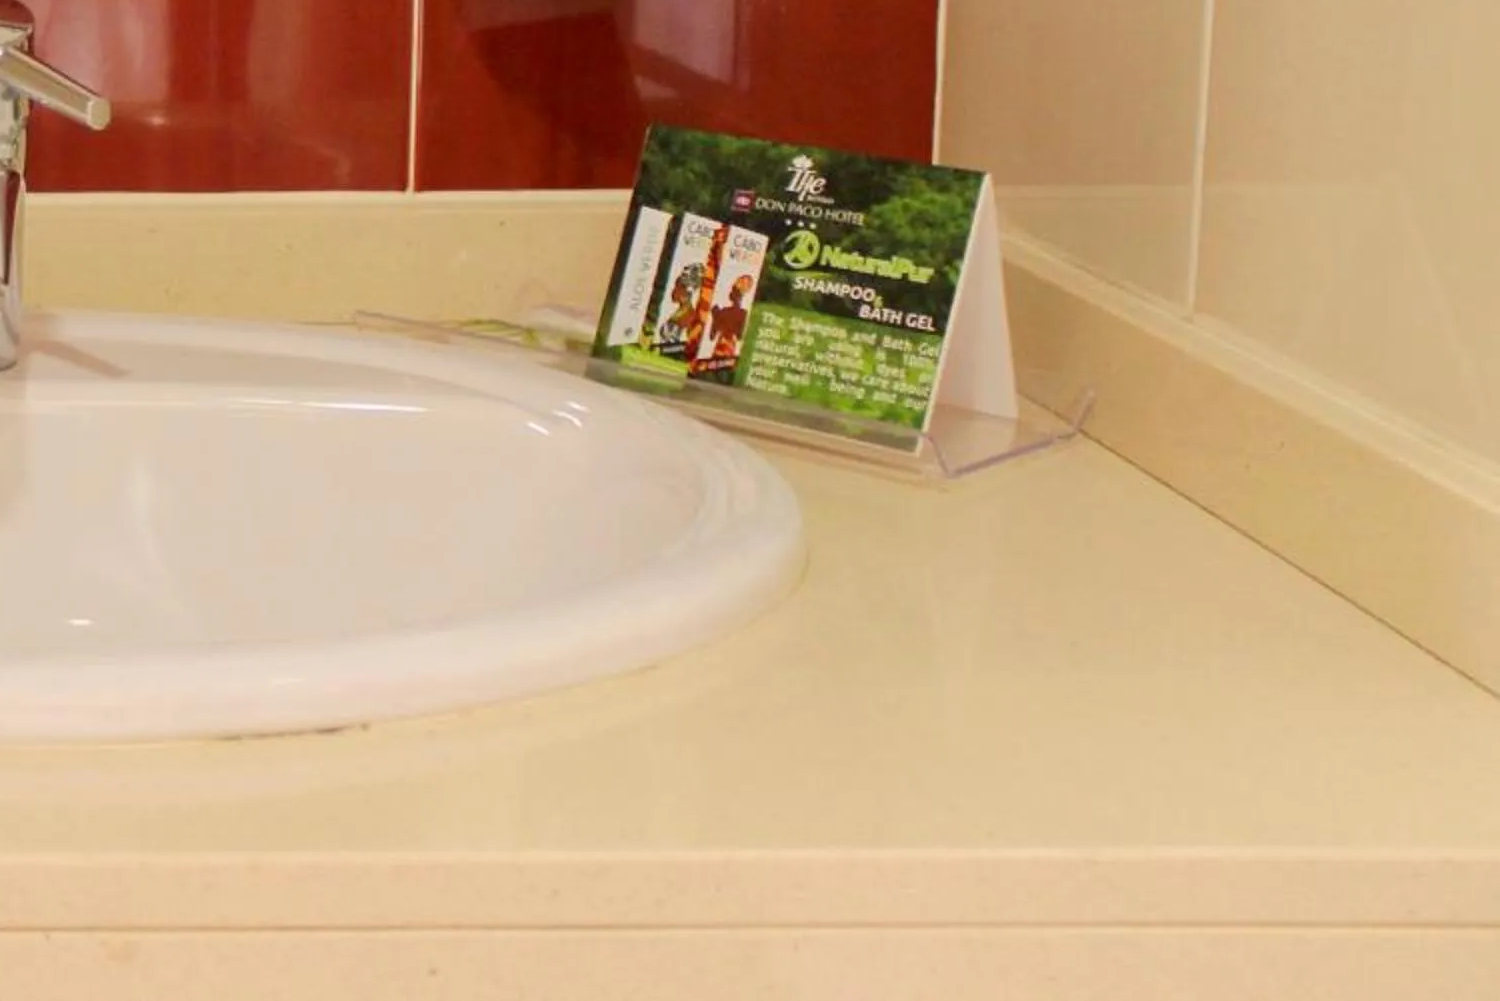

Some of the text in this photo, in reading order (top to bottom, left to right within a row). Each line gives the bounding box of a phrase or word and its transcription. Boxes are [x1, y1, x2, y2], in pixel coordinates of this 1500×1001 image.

[755, 198, 788, 213] DON
[788, 203, 823, 218] PACO
[824, 209, 866, 227] HOTEL
[793, 276, 876, 302] SHAMPOO
[859, 304, 936, 332] BATH GEL
